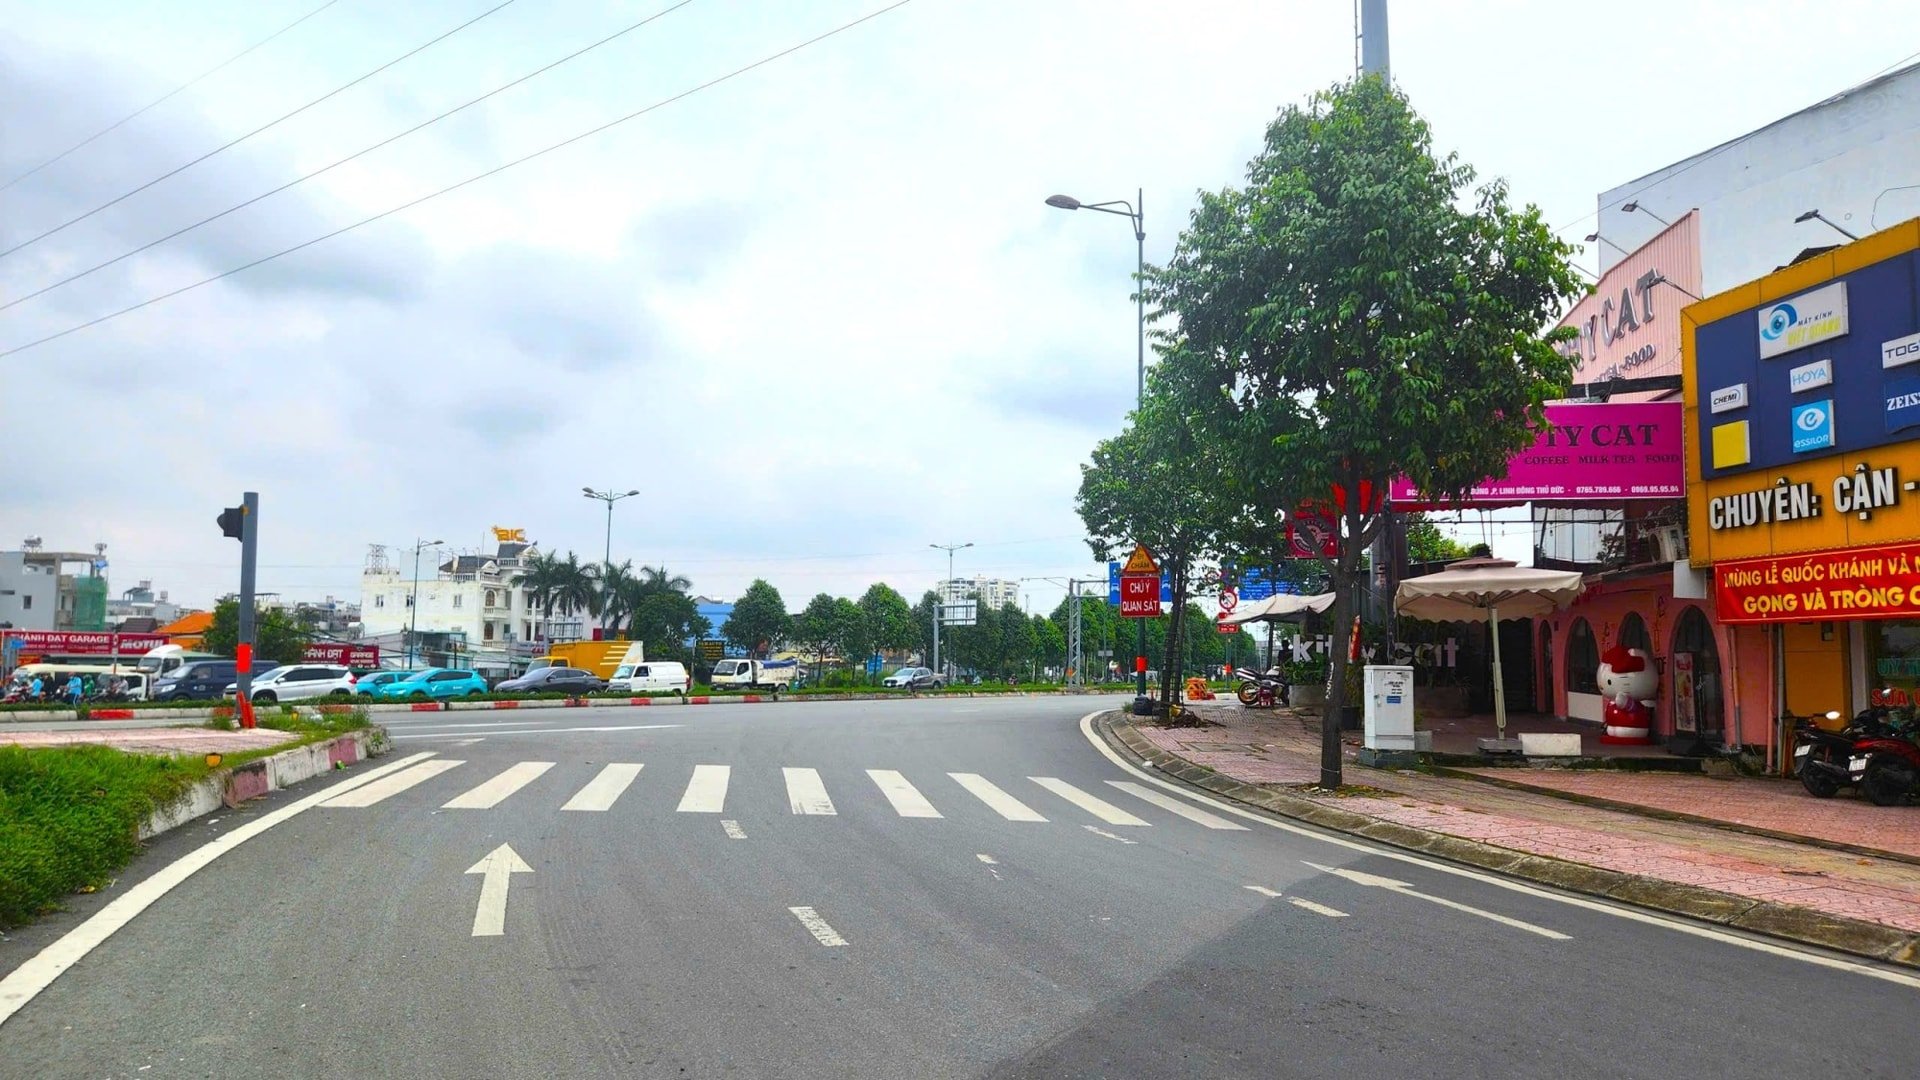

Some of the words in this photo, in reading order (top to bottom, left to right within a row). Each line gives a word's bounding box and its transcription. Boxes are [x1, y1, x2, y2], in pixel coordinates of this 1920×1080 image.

[1602, 267, 1658, 347] CAT
[1792, 367, 1827, 386] HOYA
[1713, 393, 1737, 406] CHEMI
[1887, 391, 1920, 411] ZEIS
[1590, 423, 1659, 447] CAT
[1525, 455, 1569, 465] COFFEE
[1579, 454, 1609, 464] MILK
[1613, 454, 1636, 464] TEA
[1645, 453, 1681, 463] FOOD
[1499, 487, 1515, 495] LINH
[1709, 478, 1821, 530] CHUYÊN:
[1833, 464, 1895, 520] CẬN
[1724, 568, 1762, 588] MỪNG
[1765, 562, 1778, 584] LỄ
[1782, 559, 1824, 583] QUỐC
[1829, 556, 1882, 580] KHÁNH
[1888, 552, 1911, 575] VÀ
[1130, 580, 1144, 593] CHÚ
[1145, 579, 1150, 593] Ý
[1123, 601, 1142, 612] QUAN
[1144, 598, 1158, 611] SÁT
[1743, 593, 1798, 618] GỌNG
[1802, 588, 1827, 611] VÀ
[1830, 583, 1904, 608] TRÒNG
[69, 635, 109, 644] GARAGE
[120, 639, 164, 649] MOTUL
